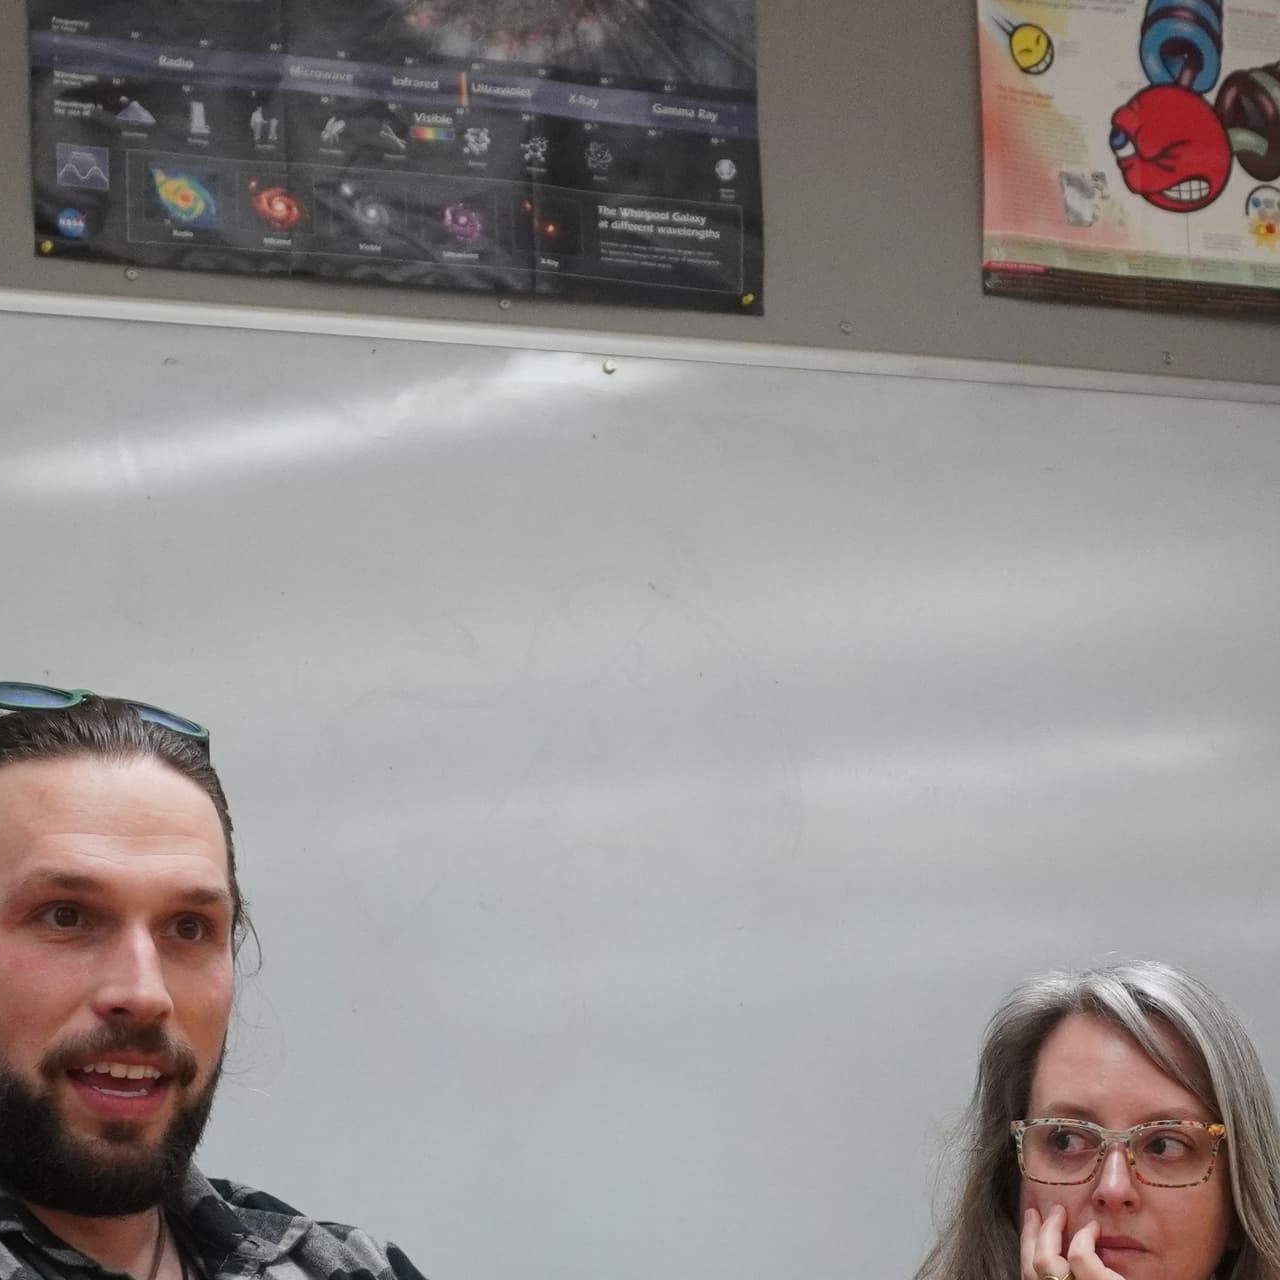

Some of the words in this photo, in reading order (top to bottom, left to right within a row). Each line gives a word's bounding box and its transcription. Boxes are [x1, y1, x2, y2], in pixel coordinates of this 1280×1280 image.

[159, 55, 194, 70] Radio
[289, 65, 354, 82] Microwave
[392, 76, 439, 90] Infrared
[471, 82, 532, 97] Ultraviolet
[413, 112, 454, 125] Visible
[652, 103, 695, 118] Gamma
[697, 108, 720, 123] Ray
[597, 205, 617, 216] The
[620, 207, 670, 221] Whirlpool
[672, 211, 707, 226] Galaxy
[598, 220, 609, 229] at
[611, 221, 655, 234] different
[657, 225, 721, 240] wavelengths
